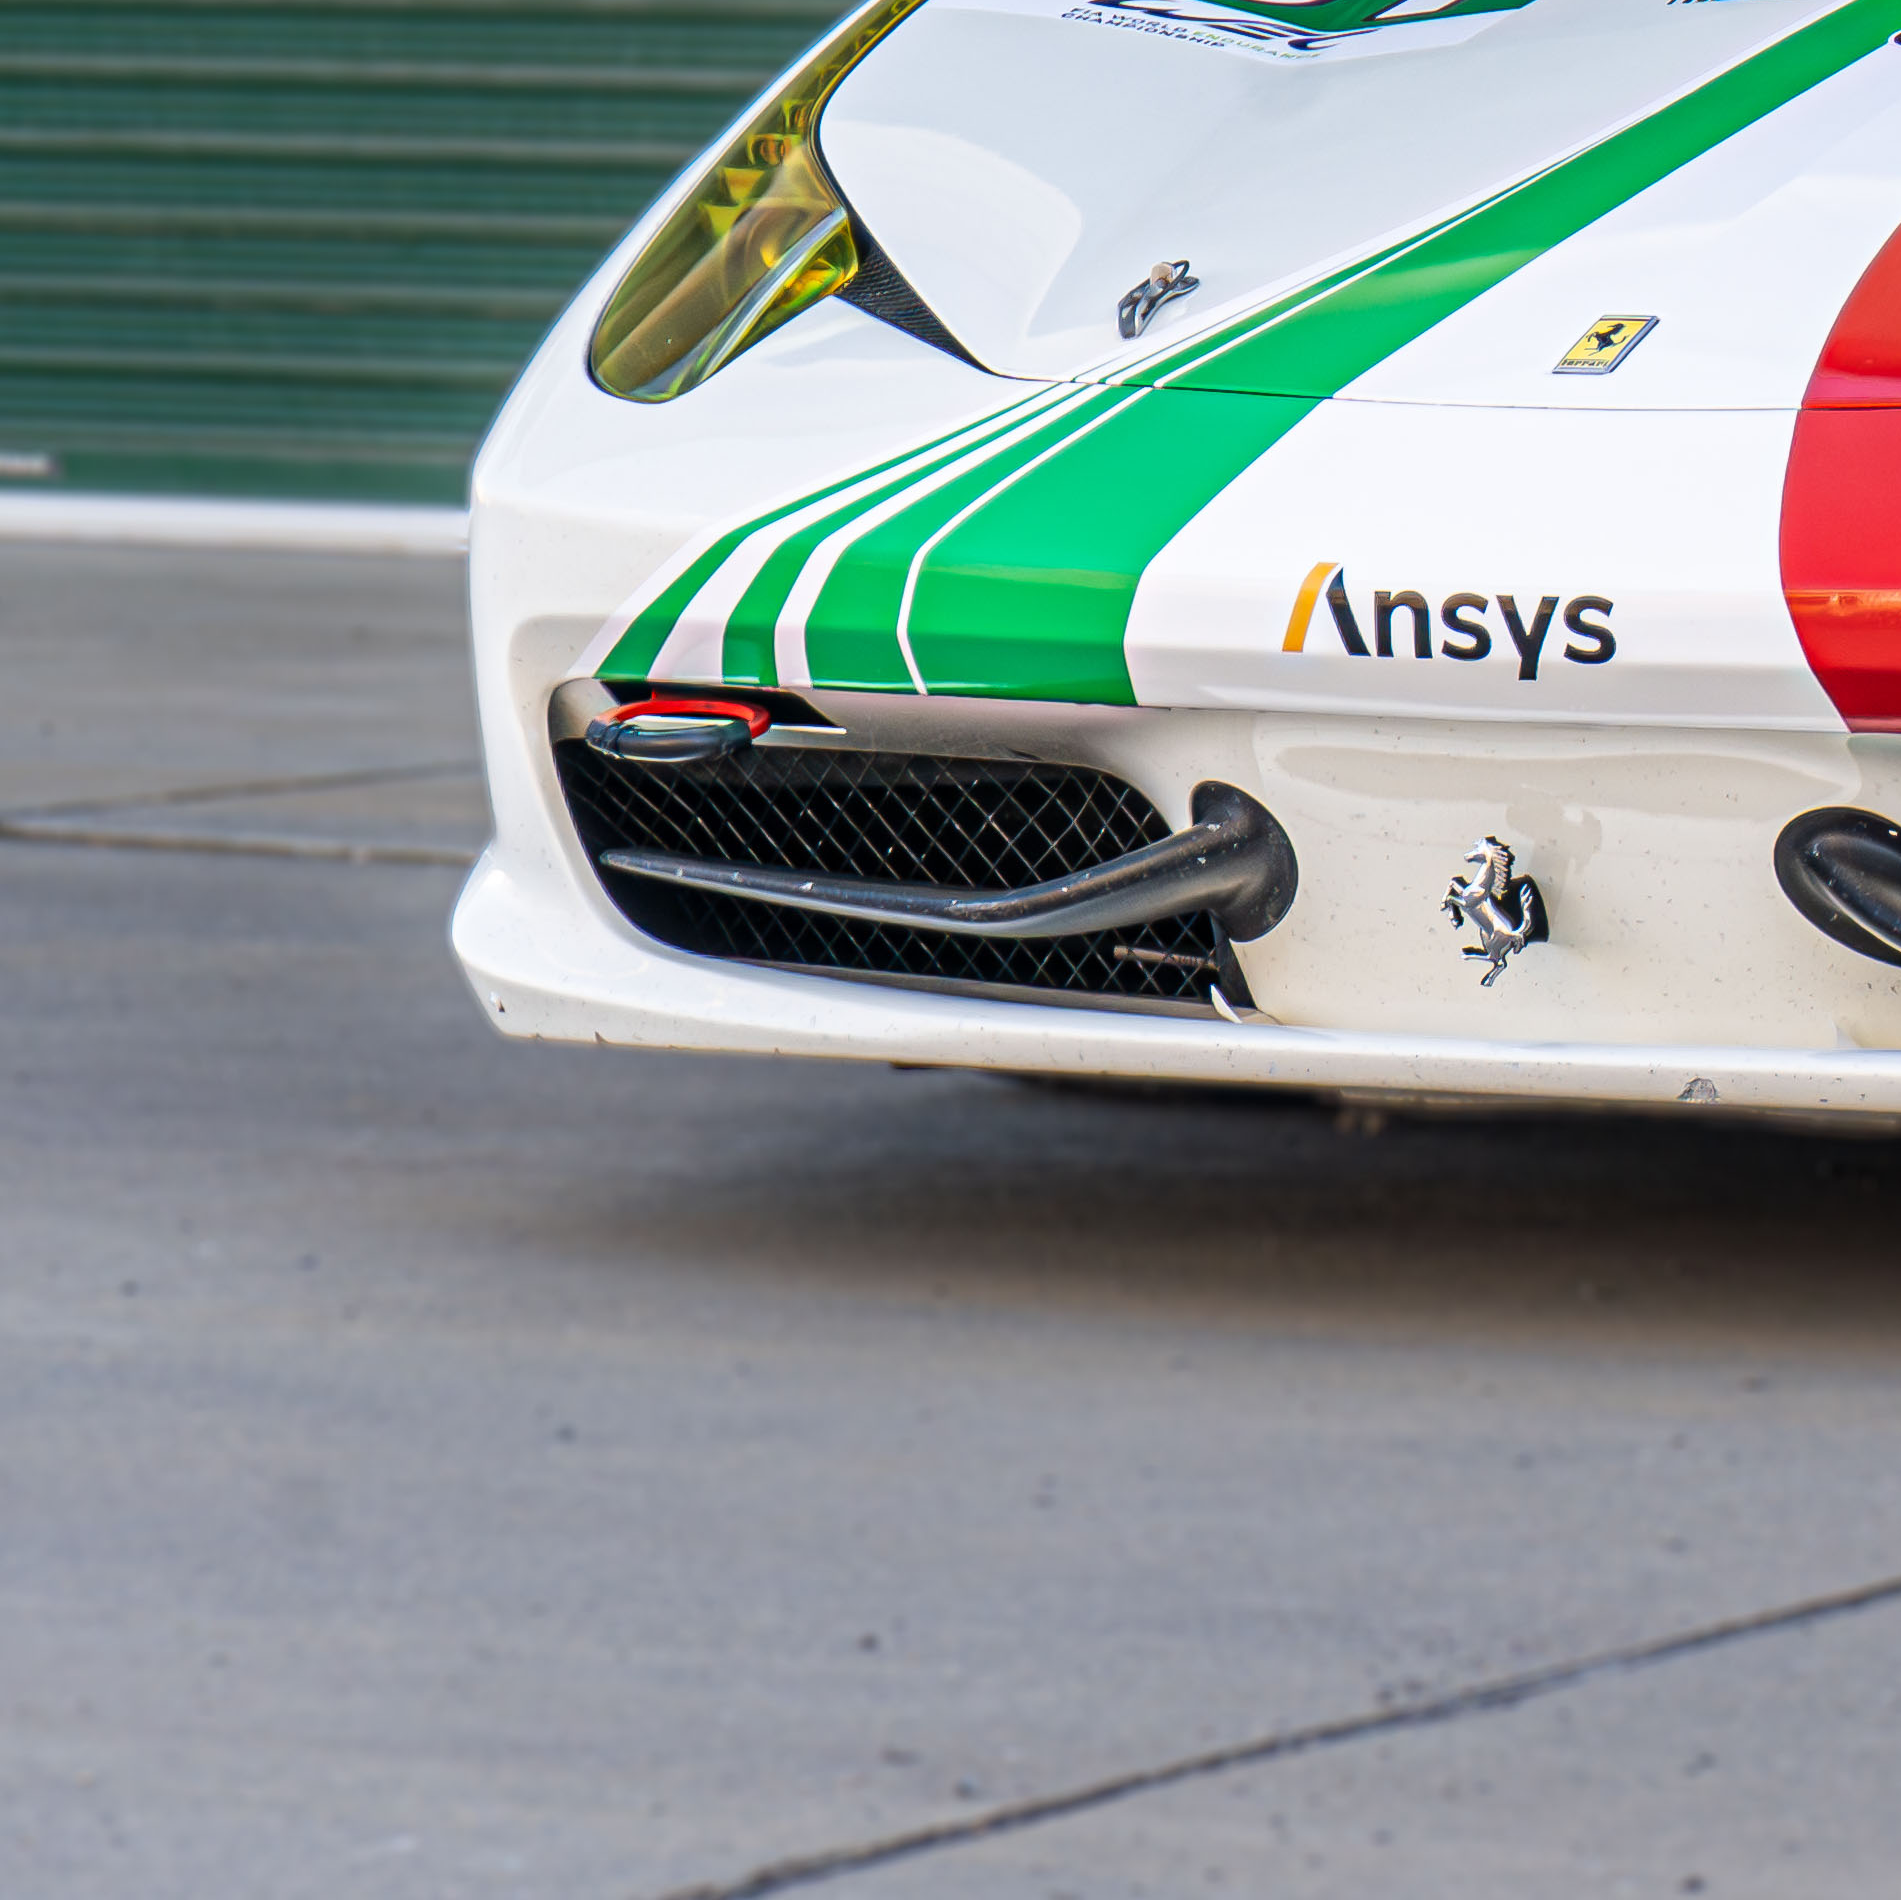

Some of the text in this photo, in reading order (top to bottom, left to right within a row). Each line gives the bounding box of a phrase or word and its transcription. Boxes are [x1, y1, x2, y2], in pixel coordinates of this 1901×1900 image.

[1061, 12, 1225, 47] CHAMPIONSHIP
[1110, 12, 1188, 33] WORLD
[1282, 561, 1617, 682] Ansys
